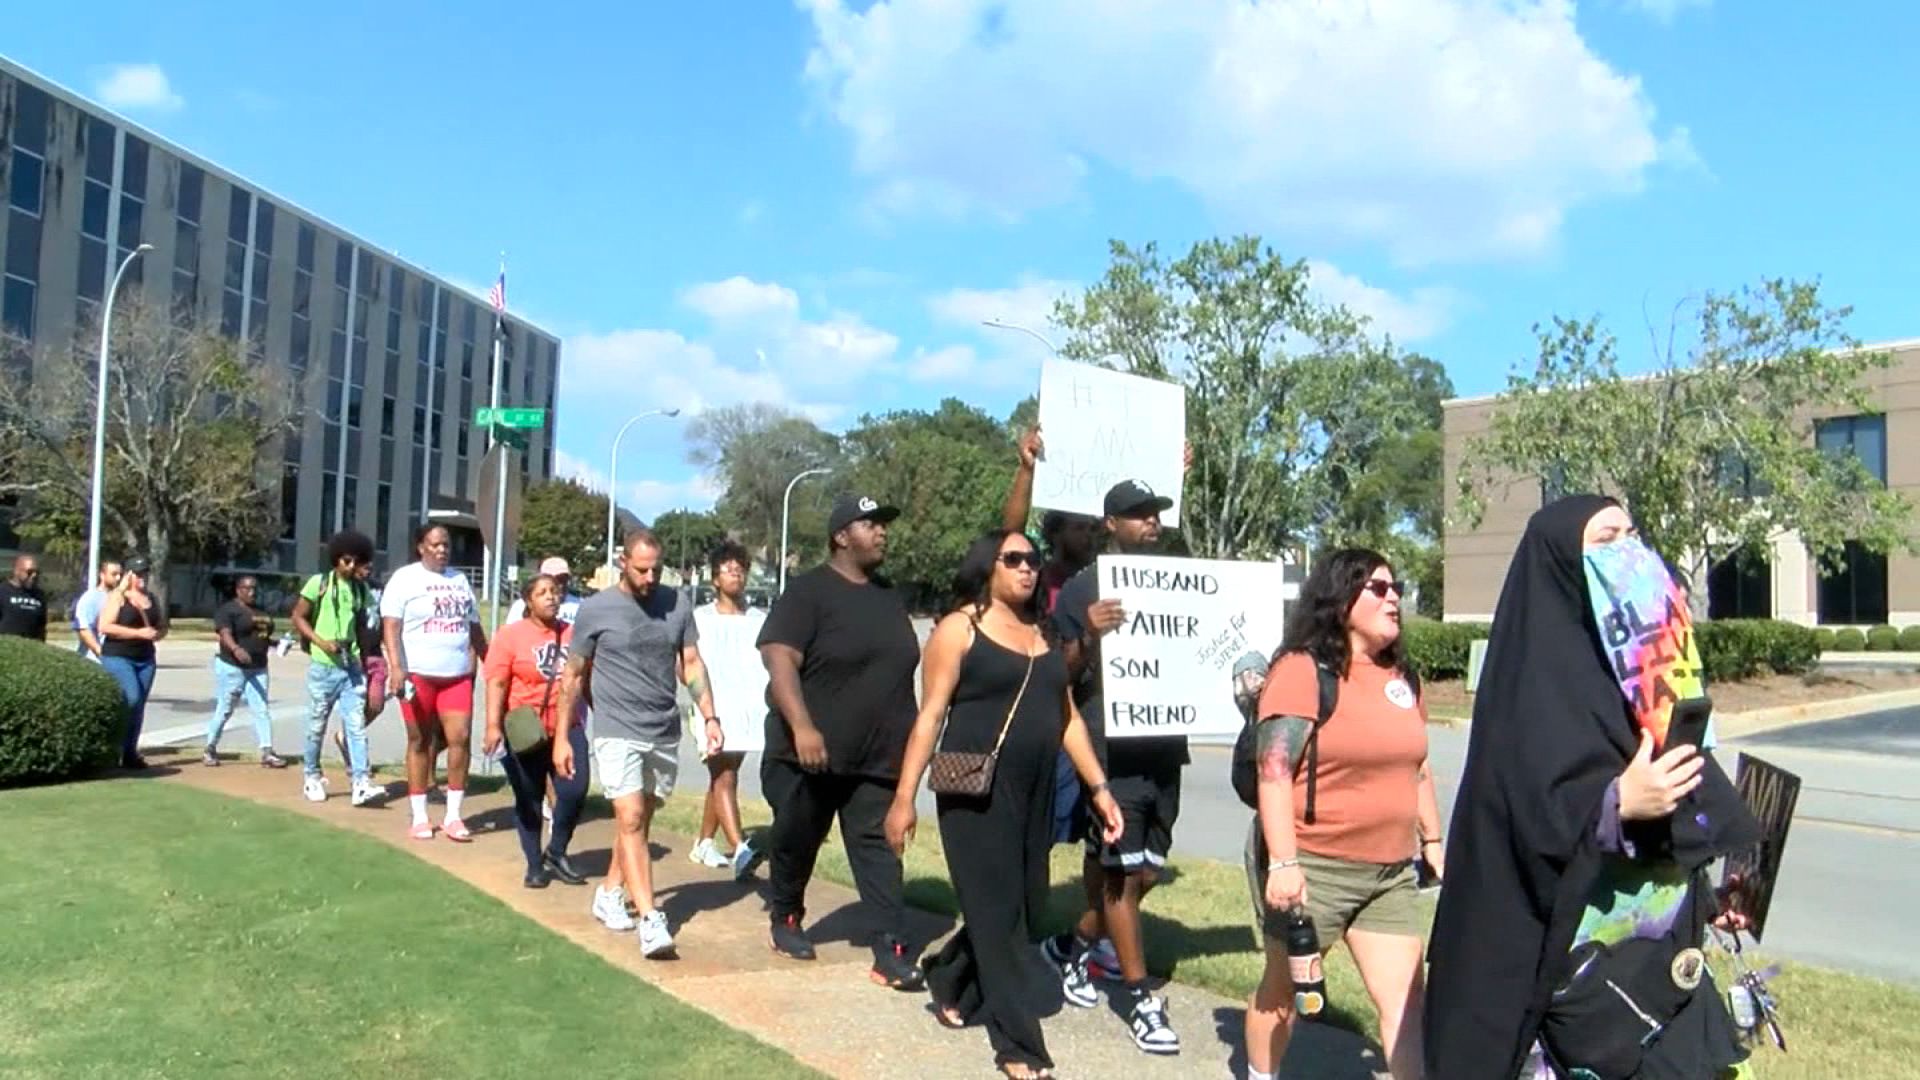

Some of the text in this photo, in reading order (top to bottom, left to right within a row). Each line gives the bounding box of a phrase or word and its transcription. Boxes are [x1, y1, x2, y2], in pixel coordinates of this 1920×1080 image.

[1111, 565, 1219, 595] HUSBAND
[1195, 629, 1230, 666] Justice
[1109, 656, 1160, 679] SON
[1112, 701, 1197, 728] FRIEND
